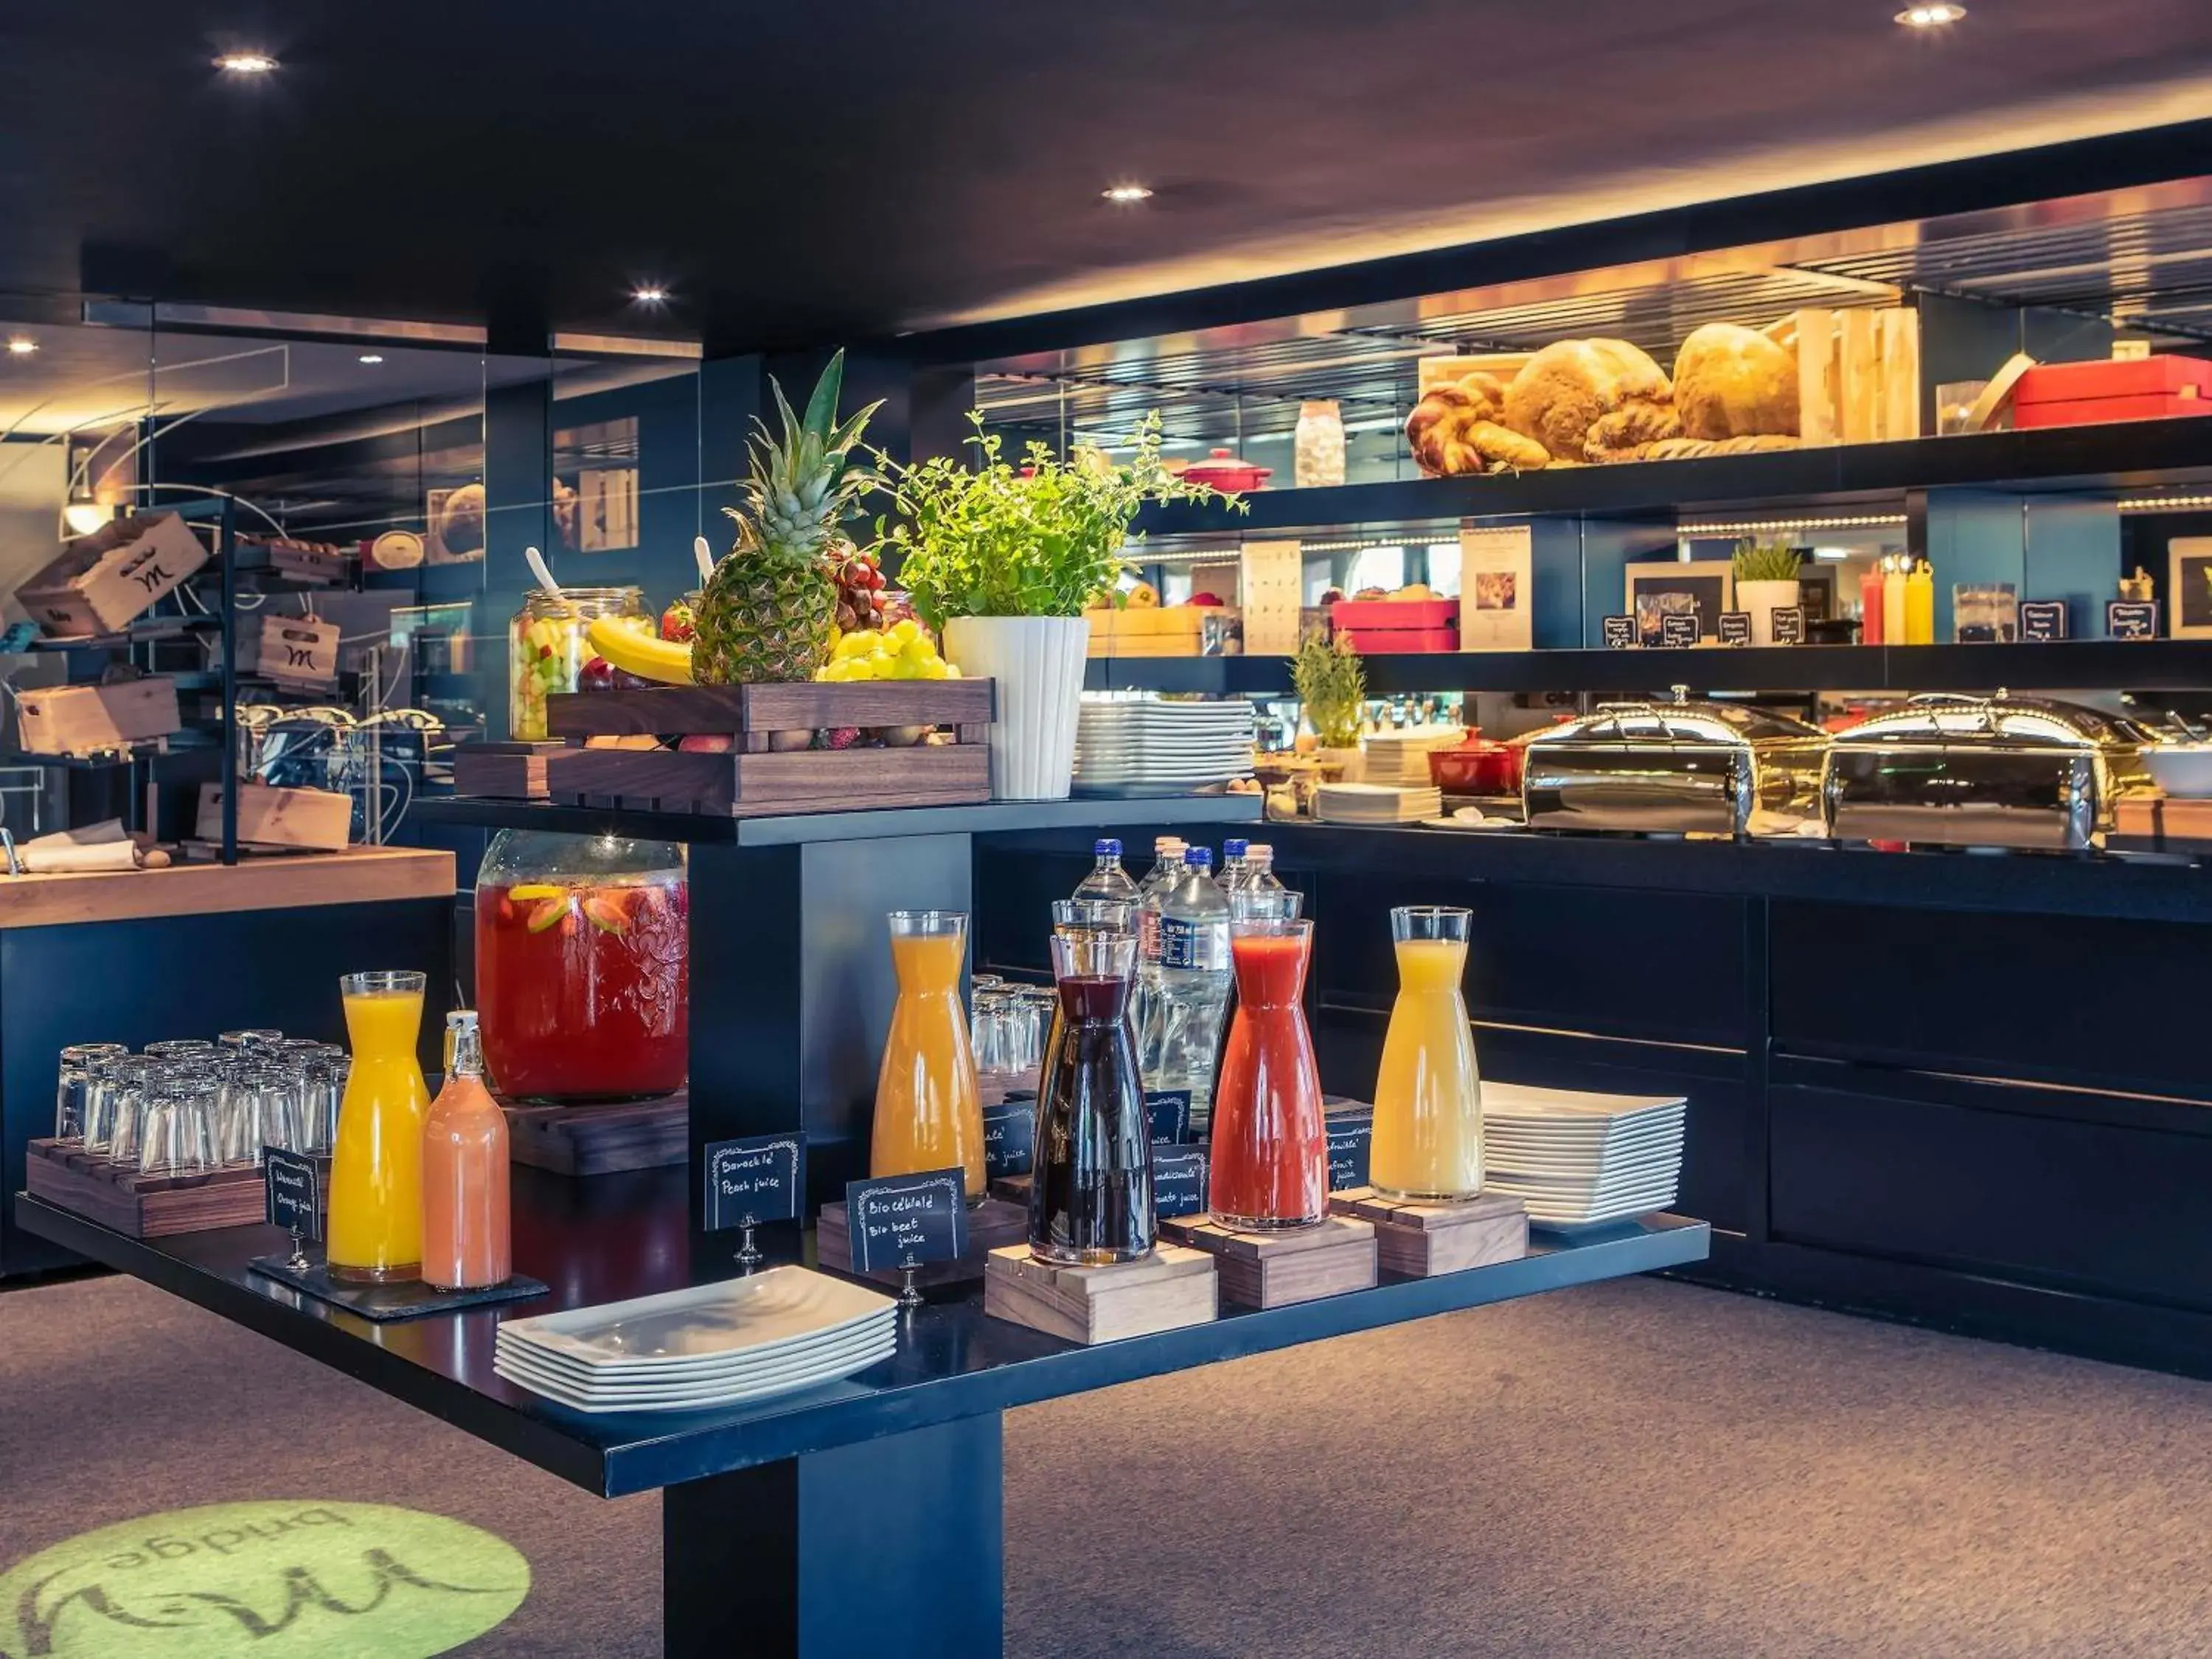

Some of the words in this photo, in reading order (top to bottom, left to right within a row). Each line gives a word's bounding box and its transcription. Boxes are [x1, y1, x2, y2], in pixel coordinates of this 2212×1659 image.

[754, 1177, 779, 1192] juice
[891, 1217, 918, 1232] beet
[897, 1234, 925, 1249] juice
[102, 1506, 355, 1570] bridge
